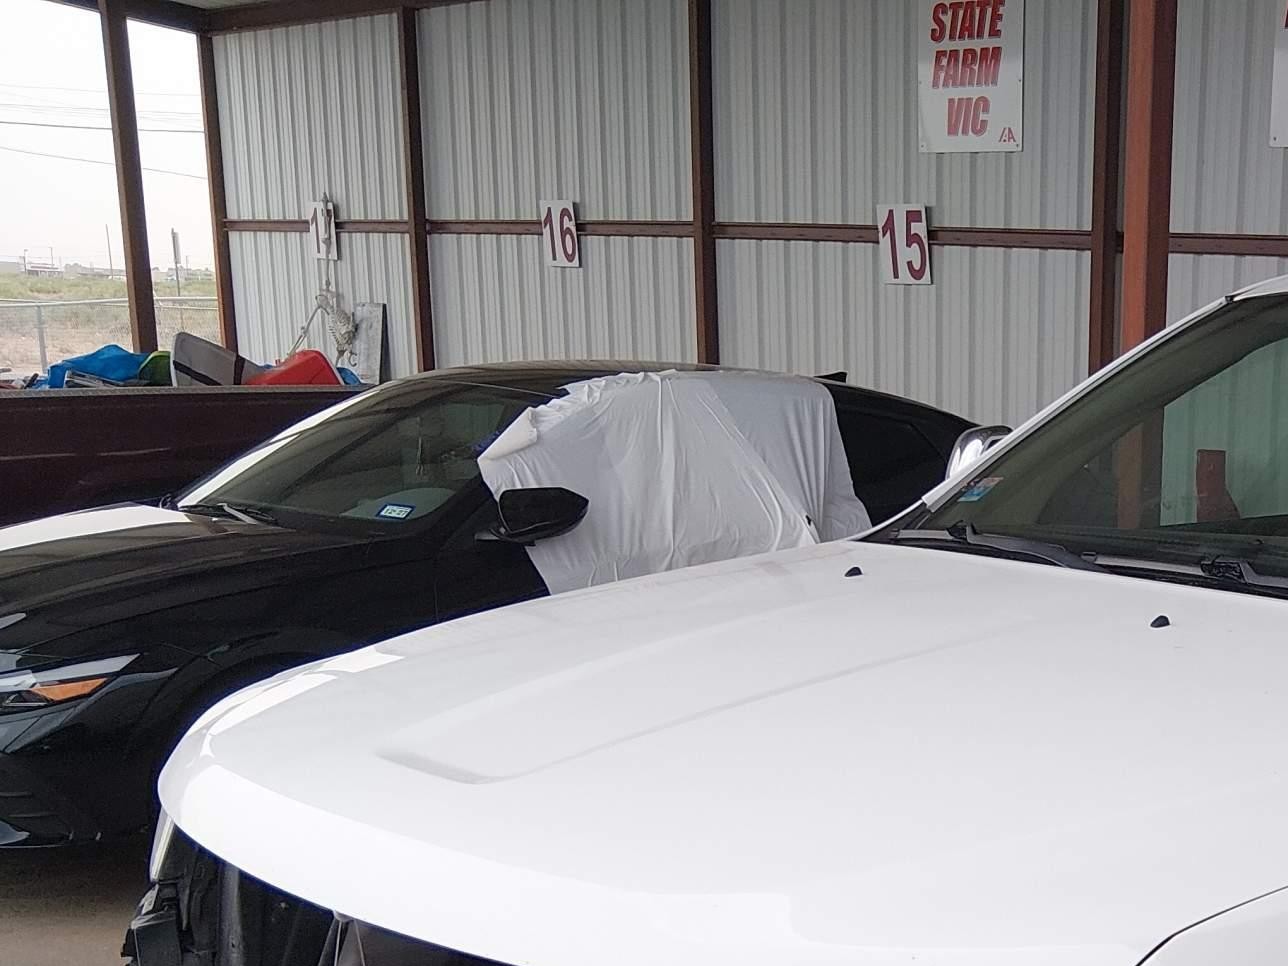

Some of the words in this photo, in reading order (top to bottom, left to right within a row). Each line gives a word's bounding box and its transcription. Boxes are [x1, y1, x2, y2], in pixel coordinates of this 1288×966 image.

[930, 0, 1005, 42] STATE
[931, 46, 1002, 89] FARM
[947, 96, 990, 137] VIC
[544, 207, 576, 263] 16
[882, 209, 926, 280] 15
